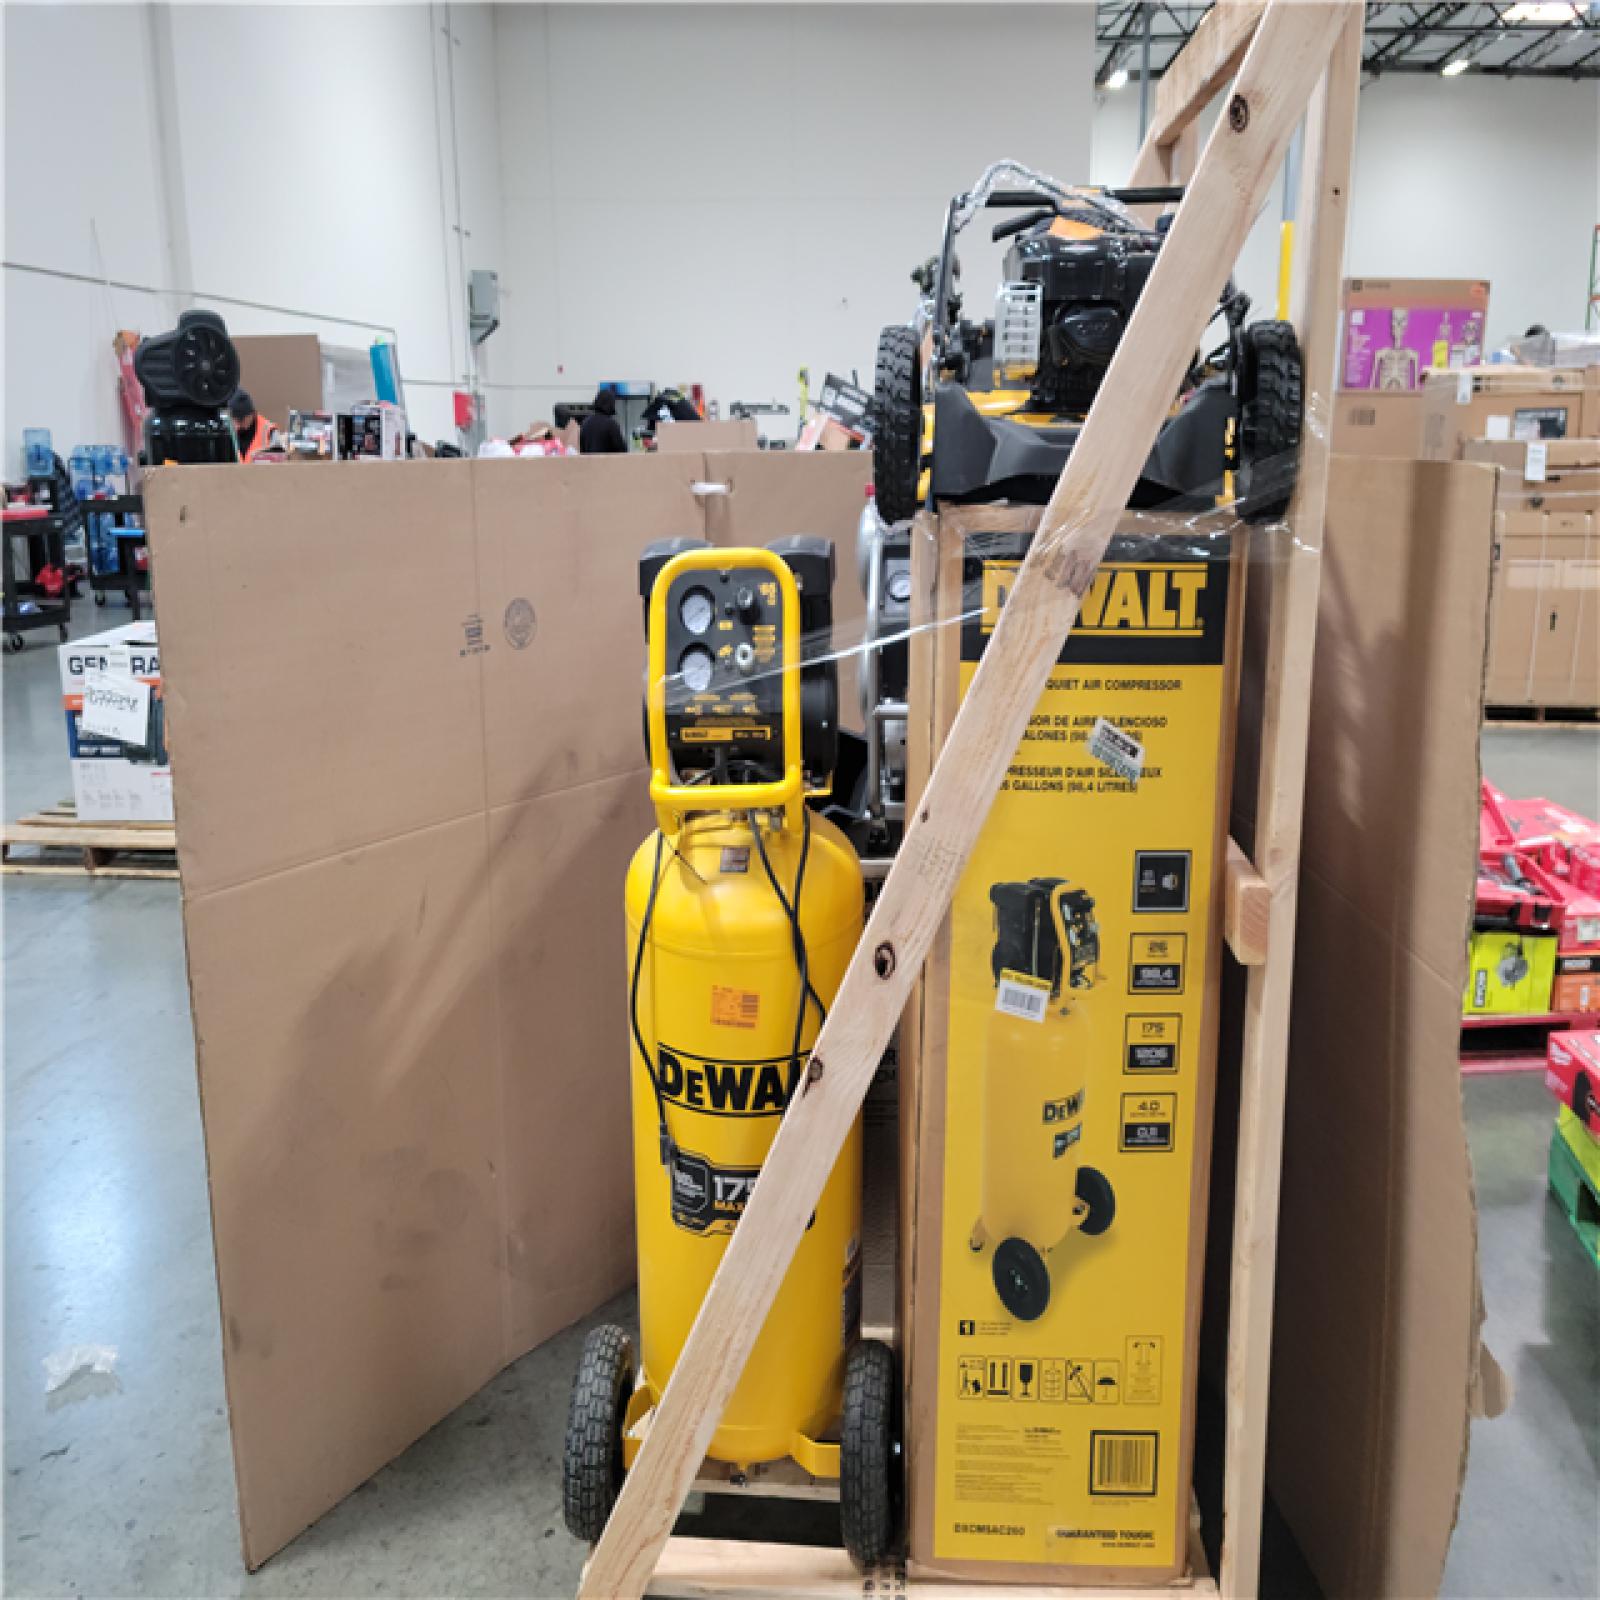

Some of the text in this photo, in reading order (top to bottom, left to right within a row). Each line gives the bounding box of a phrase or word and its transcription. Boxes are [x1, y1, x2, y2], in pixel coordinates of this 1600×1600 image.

[981, 570, 1208, 627] DWALT
[1082, 680, 1102, 690] AIR
[1104, 680, 1182, 690] COMPRESSOR
[1054, 716, 1069, 726] DE
[1022, 730, 1067, 740] ALONES
[1012, 780, 1064, 791] GALLONS
